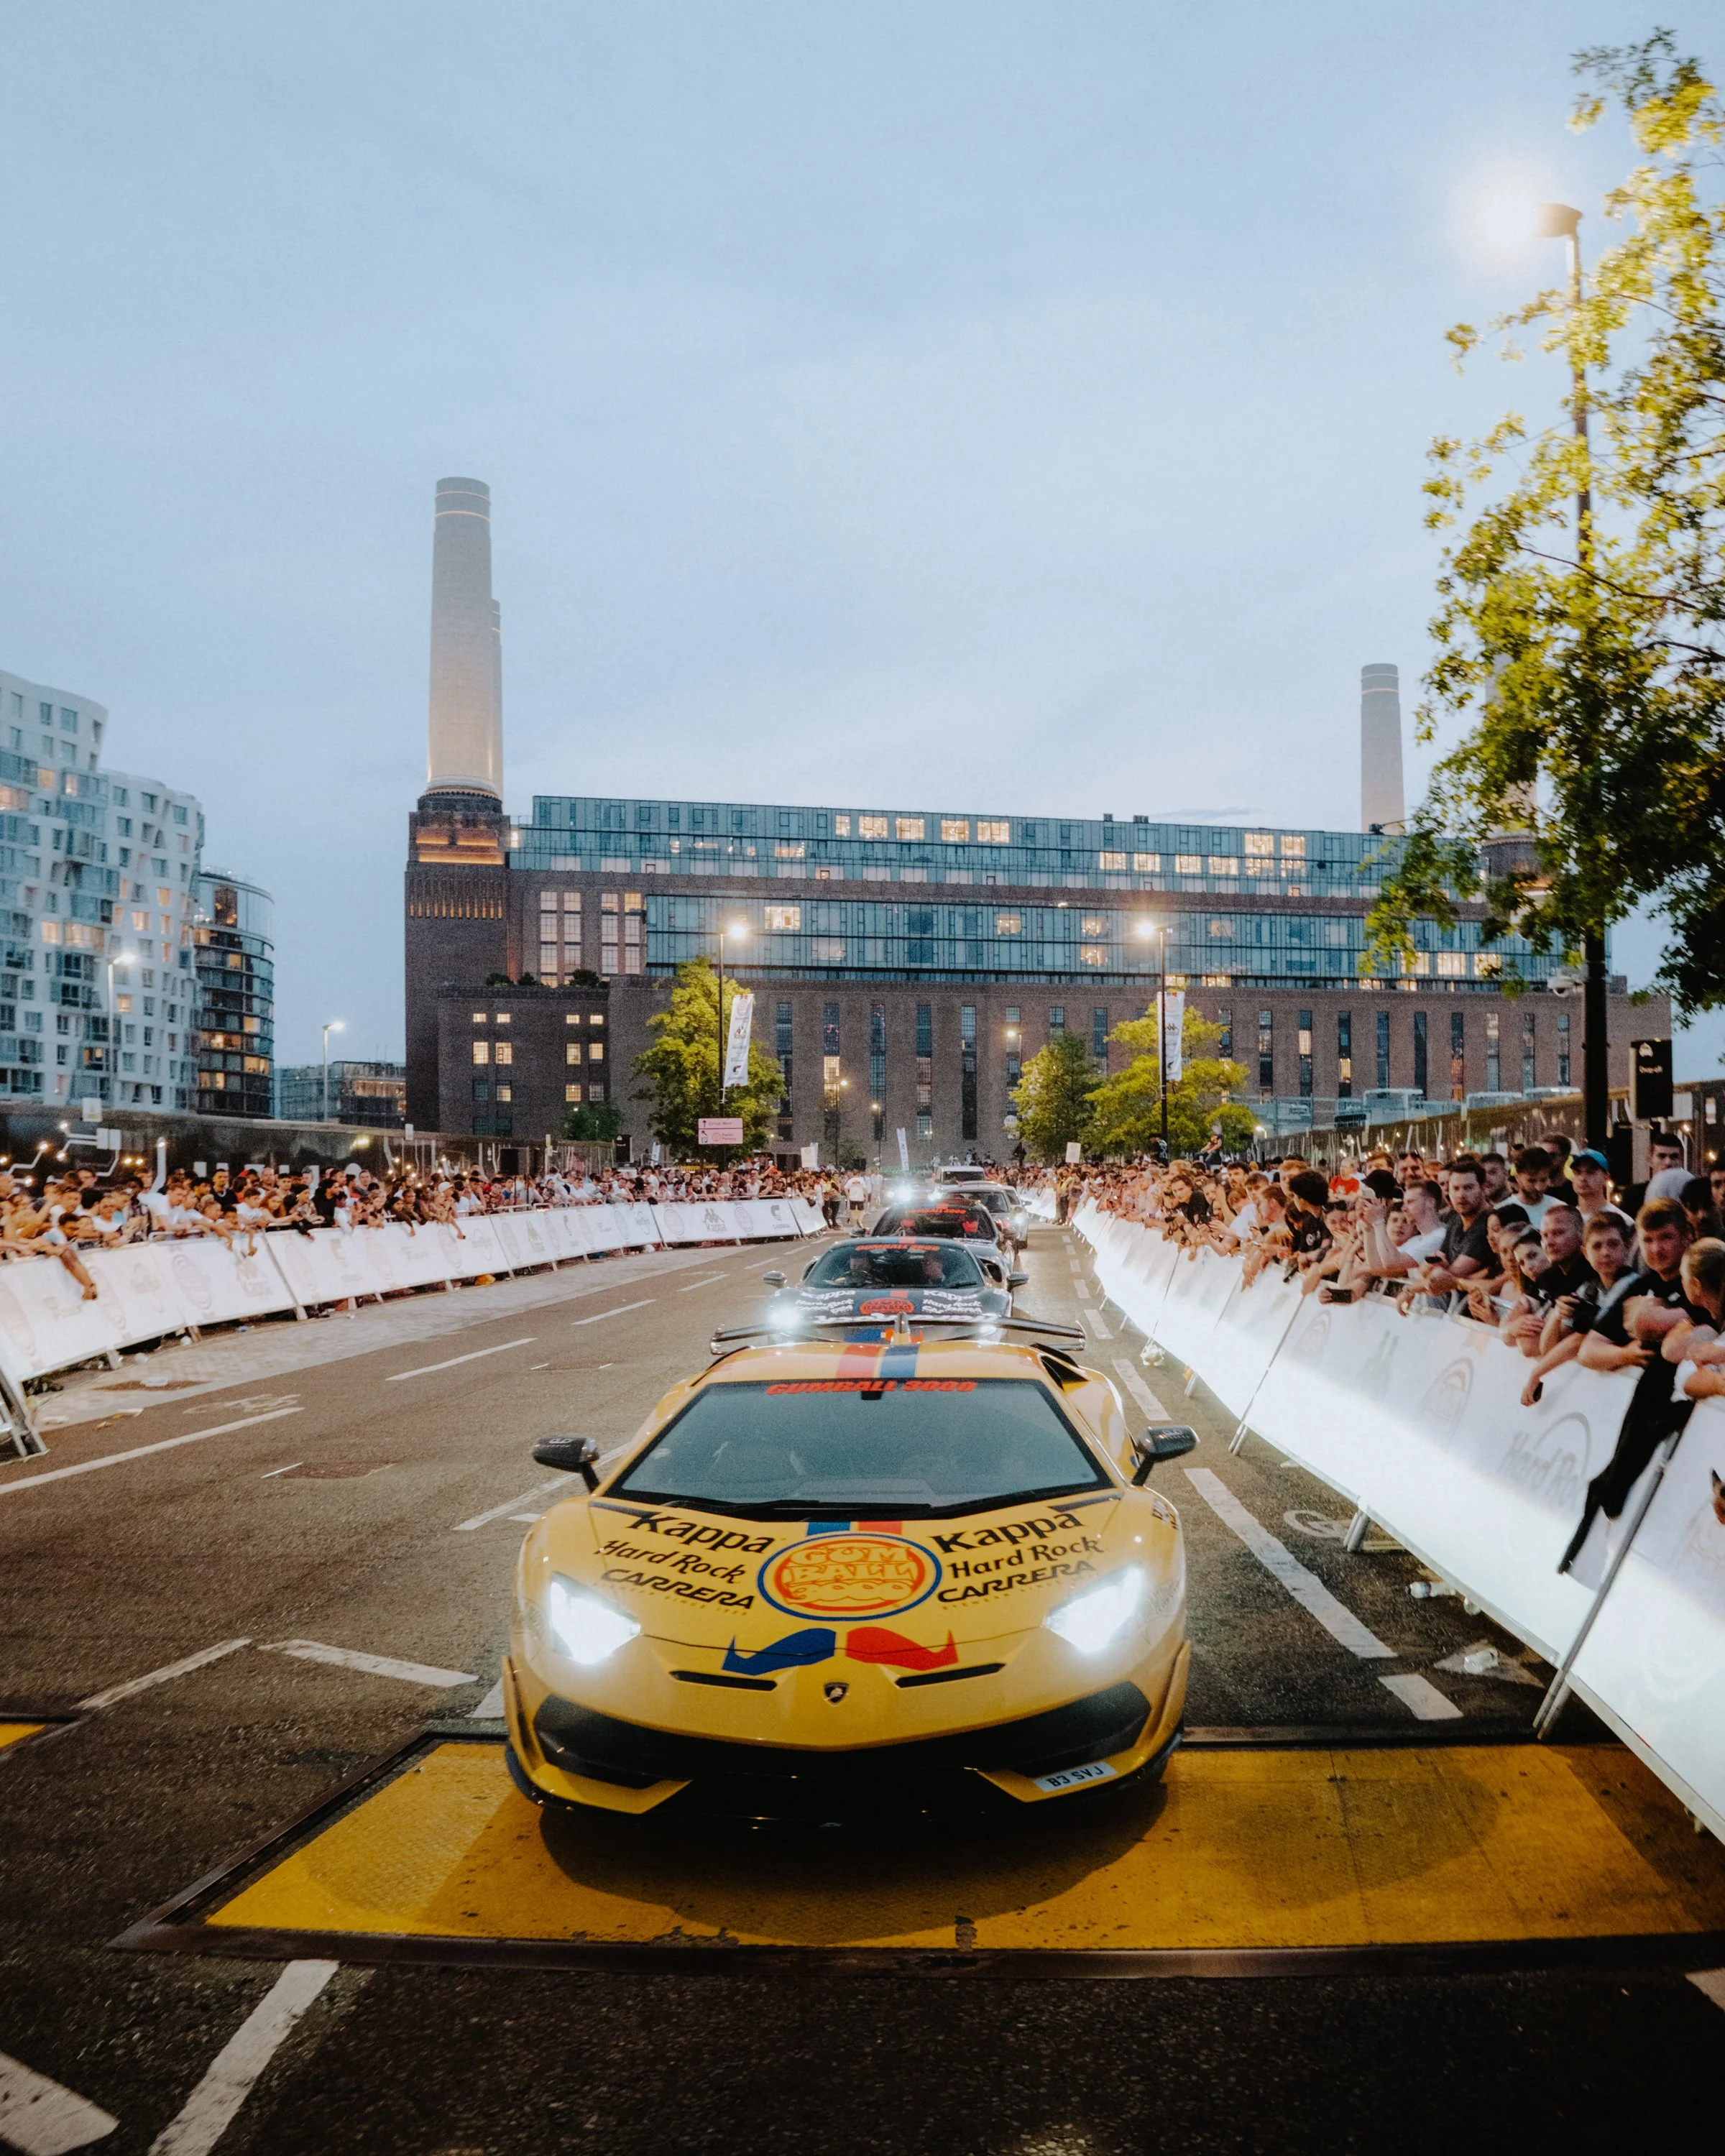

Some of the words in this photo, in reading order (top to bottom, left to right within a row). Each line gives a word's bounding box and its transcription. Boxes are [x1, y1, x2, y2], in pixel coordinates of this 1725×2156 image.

[765, 1381, 898, 1395] GUMBALL
[902, 1381, 978, 1392] 3000
[625, 1512, 775, 1554] Kappa
[930, 1513, 1086, 1554] Kappa
[594, 1540, 679, 1565] Hard
[669, 1554, 745, 1584] Rock
[784, 1562, 916, 1585] BALL
[947, 1549, 1024, 1579] Hard
[1028, 1536, 1104, 1562] Rock
[601, 1569, 755, 1609] CARRERA
[783, 1581, 914, 1605] 3000
[937, 1560, 1097, 1603] CARRERA
[1046, 1775, 1071, 1787] B3
[1071, 1766, 1105, 1780] SVJ
